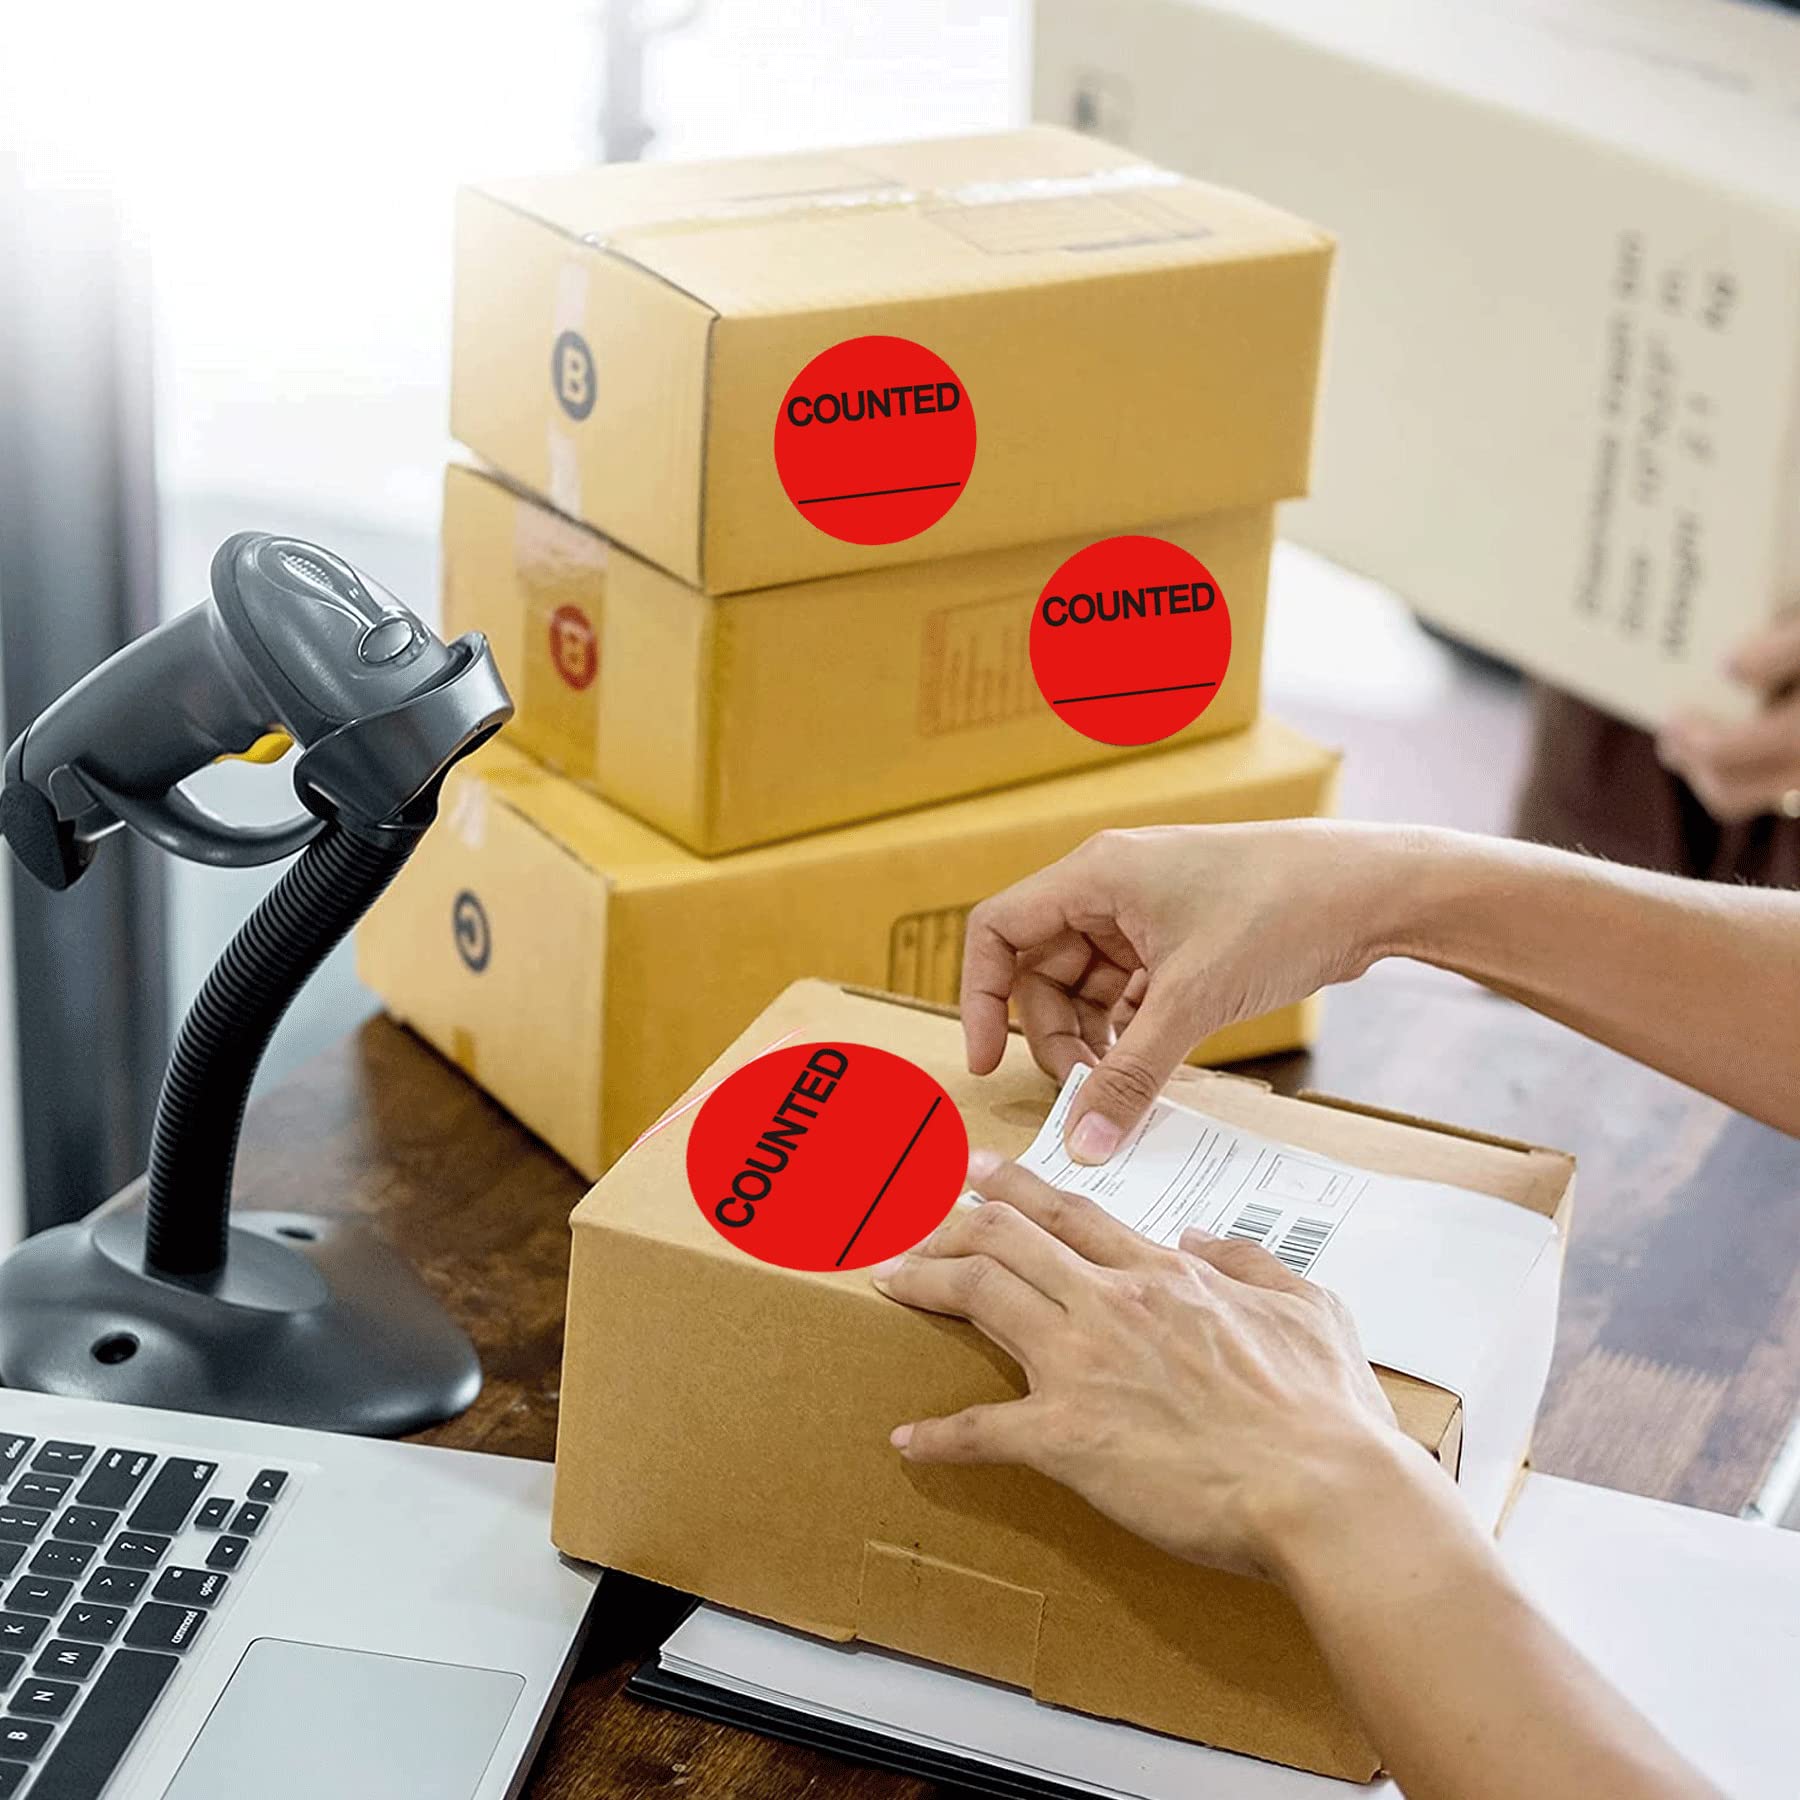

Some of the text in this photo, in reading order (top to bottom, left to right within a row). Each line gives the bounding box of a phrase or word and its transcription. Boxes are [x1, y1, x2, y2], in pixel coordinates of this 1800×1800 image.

[788, 383, 959, 427] COUNTED
[1043, 583, 1214, 627] COUNTED
[716, 1049, 849, 1230] COUNTED
[171, 1609, 199, 1644] command
[57, 1651, 80, 1665] M
[32, 1690, 55, 1702] N
[7, 1731, 29, 1741] B
